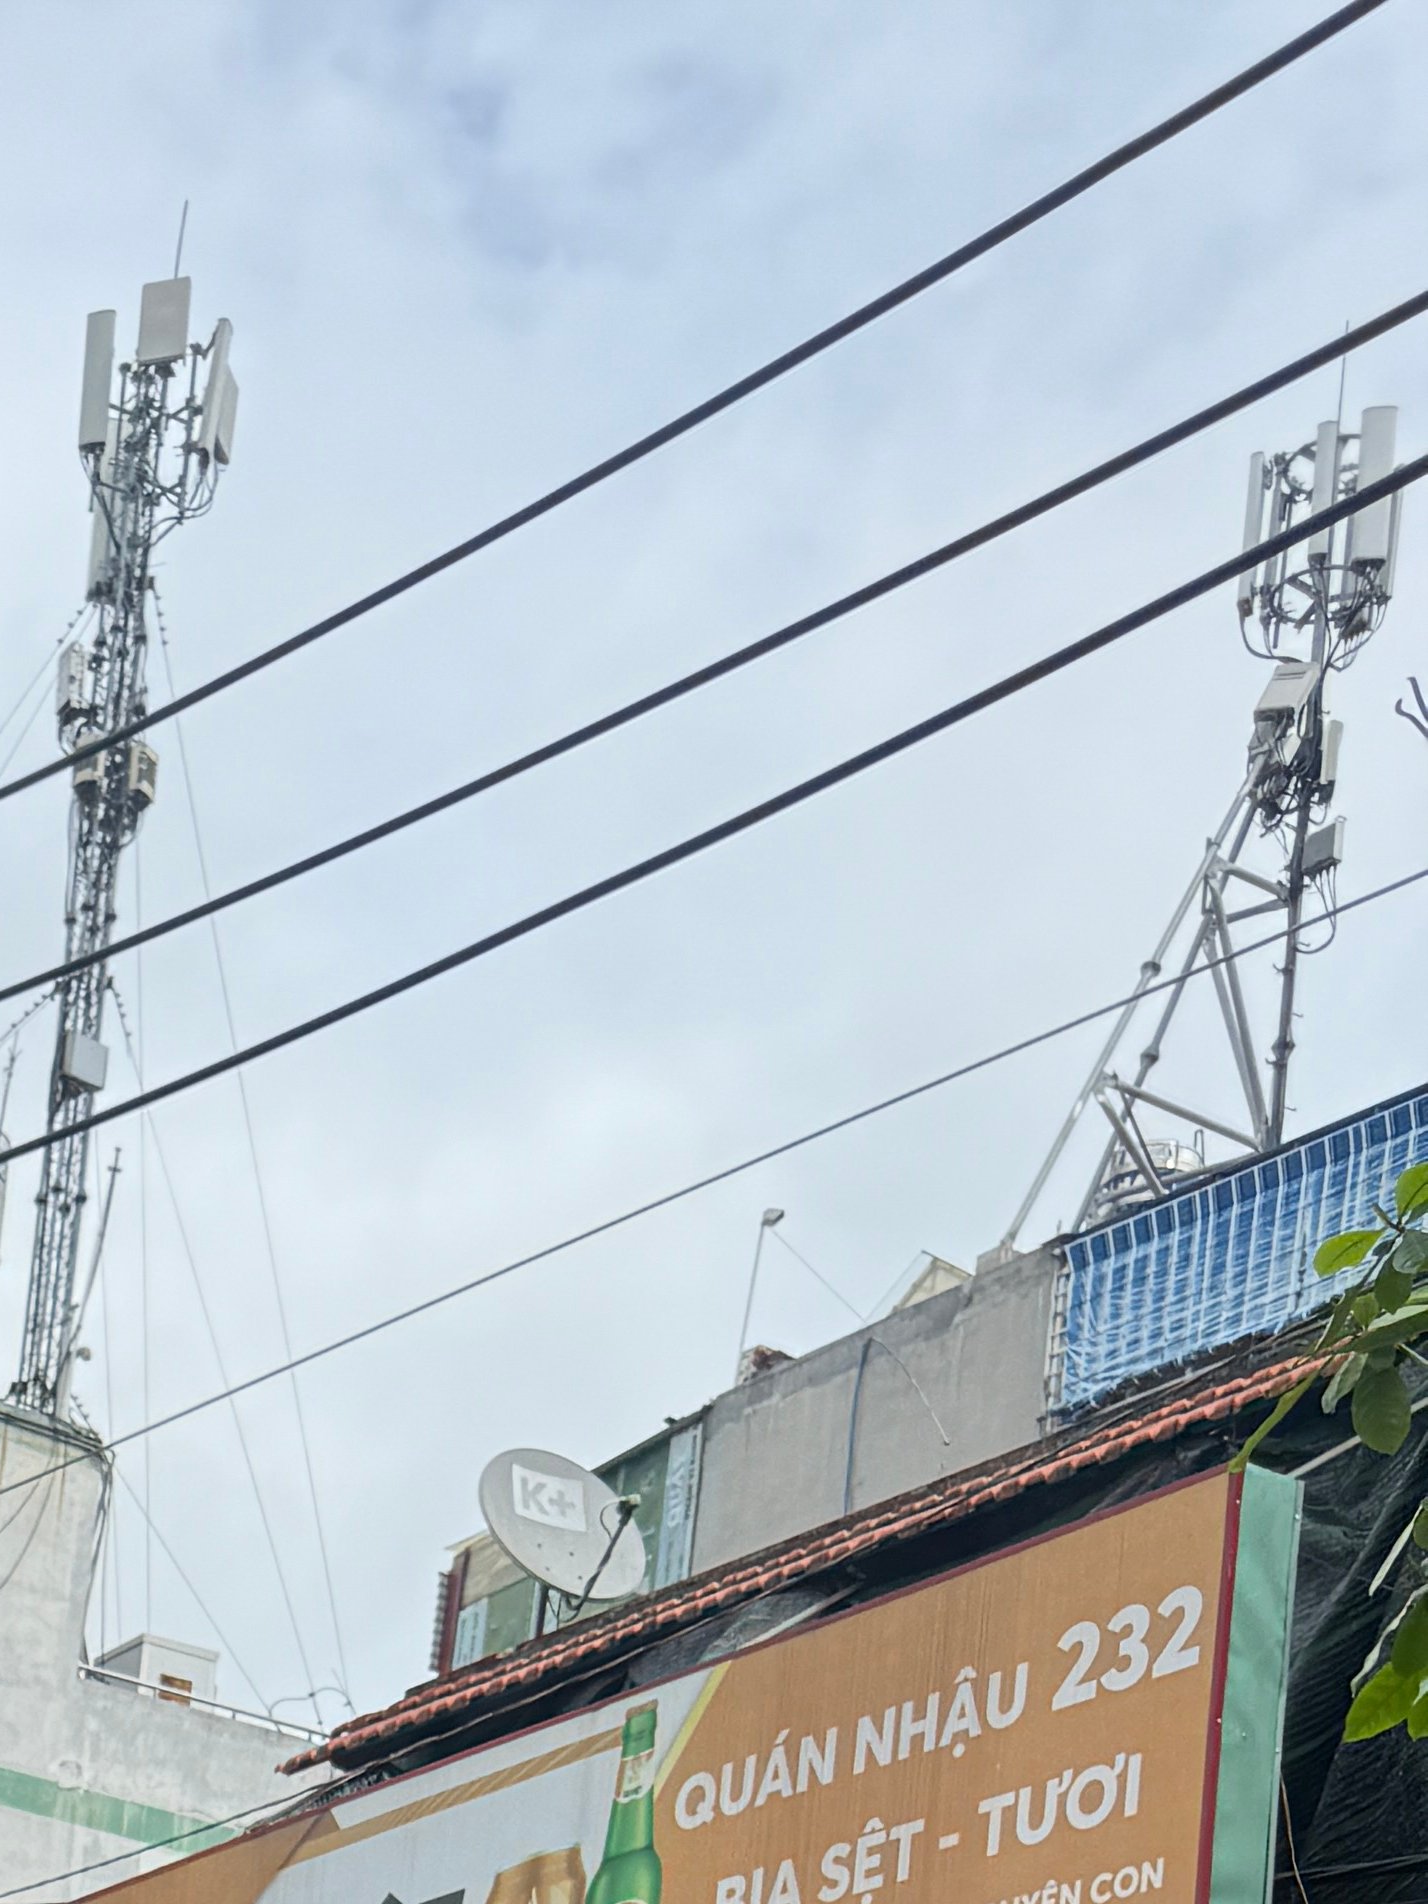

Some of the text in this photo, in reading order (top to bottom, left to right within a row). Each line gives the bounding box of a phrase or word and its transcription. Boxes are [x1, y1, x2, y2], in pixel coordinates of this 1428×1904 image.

[674, 1584, 1204, 1830] QUÁN NHẬU 232
[978, 1752, 1143, 1857] TƯƠI
